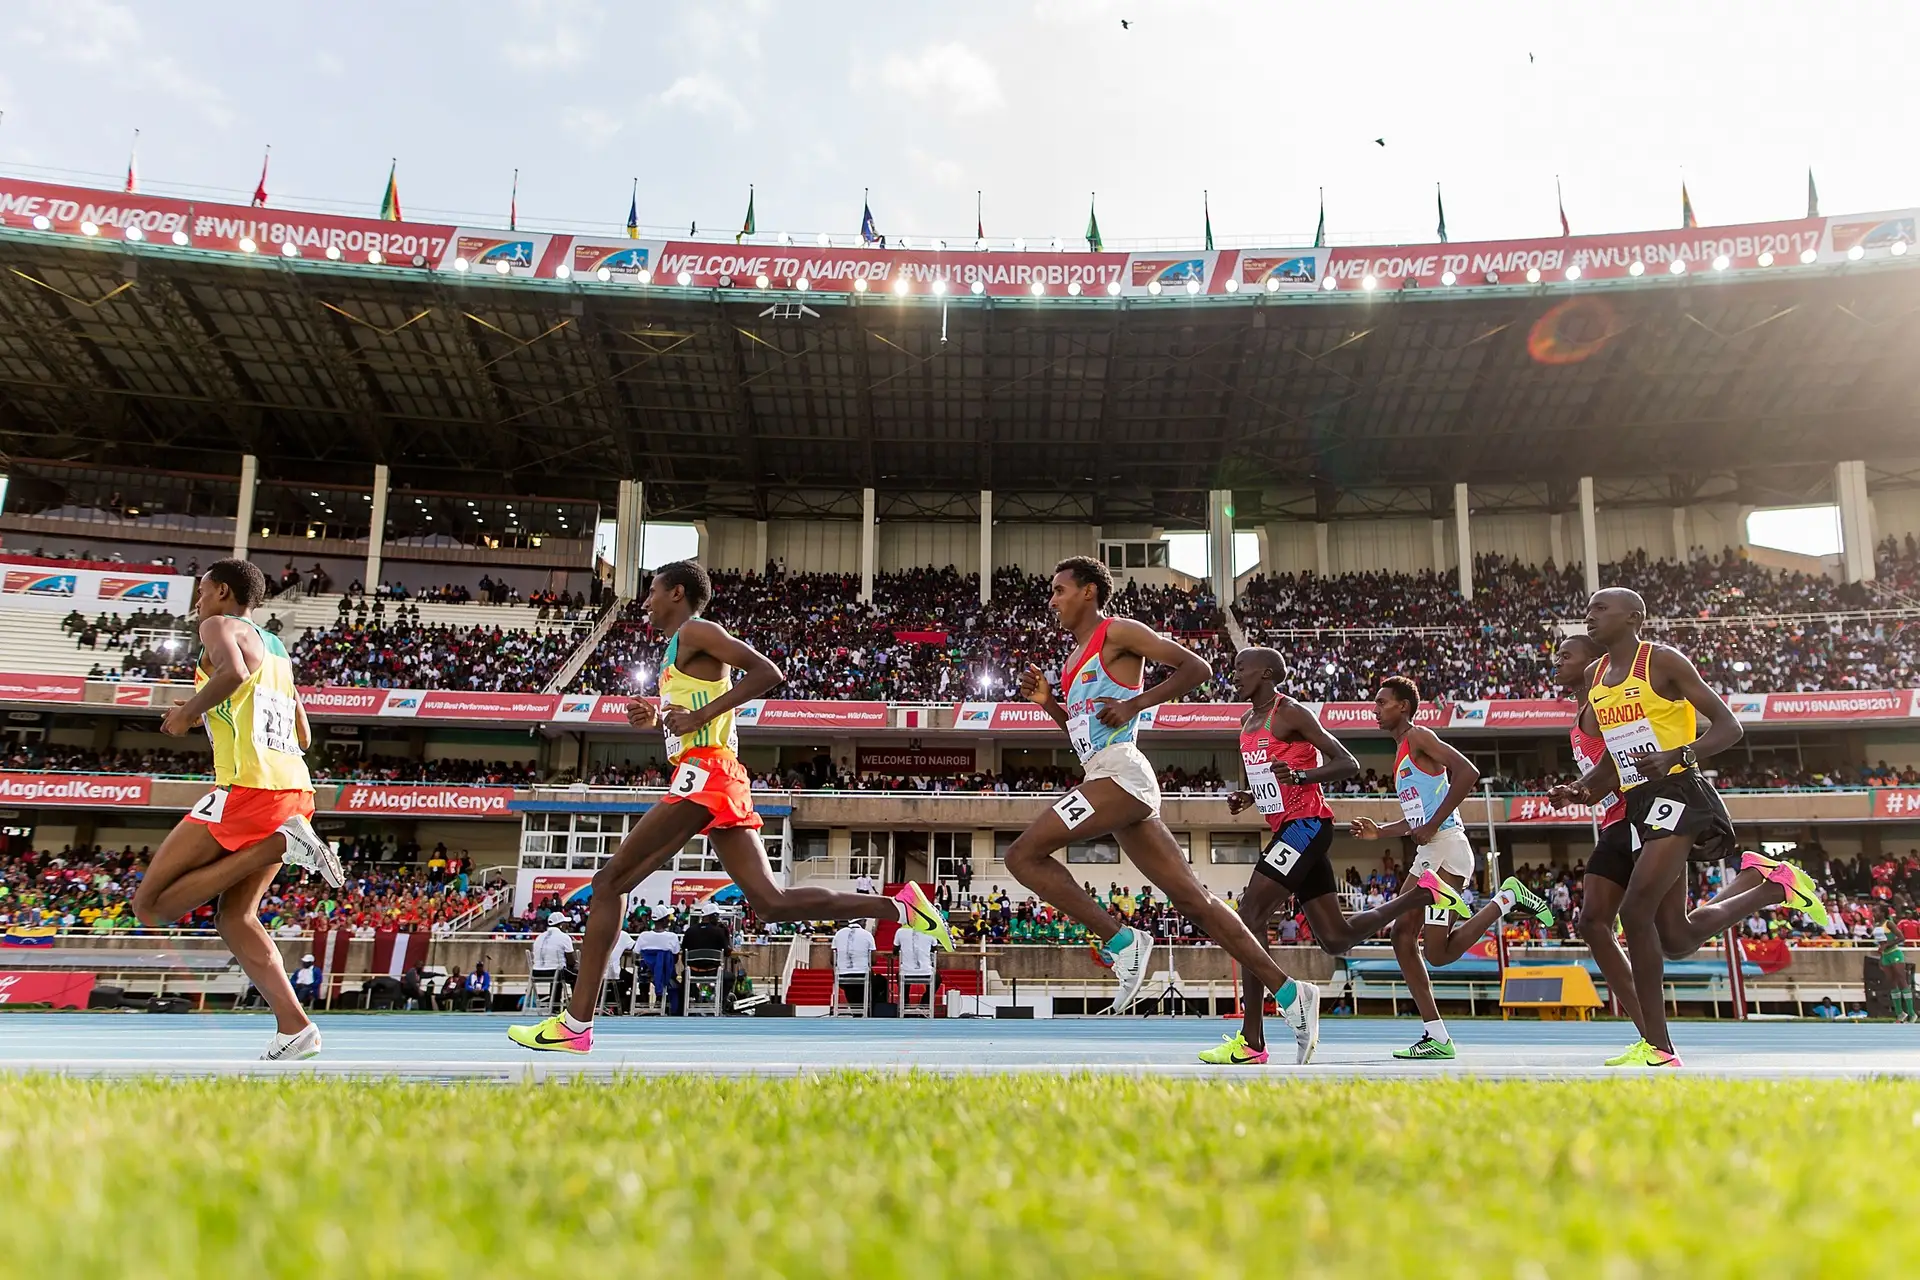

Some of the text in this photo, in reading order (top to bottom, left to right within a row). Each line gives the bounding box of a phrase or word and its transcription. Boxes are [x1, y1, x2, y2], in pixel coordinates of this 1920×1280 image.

[0, 193, 188, 233] ME TO NAIROBI
[194, 215, 446, 258] #WU18NAIROBI2017
[1571, 231, 1819, 270] #WU18NAIROBI2017
[661, 254, 891, 281] WELCOME TO NAIROBI
[898, 262, 1121, 285] #WU18NAIROBI2017
[1328, 249, 1565, 279] WELCOME TO NAIROBI
[424, 701, 443, 709] WU18
[458, 702, 500, 711] Performance
[526, 704, 550, 712] Record
[796, 711, 836, 719] Performance
[860, 712, 884, 720] Record
[1509, 711, 1525, 719] Best
[1525, 710, 1566, 719] Performance
[1772, 697, 1902, 713] #WU18NAIROBI2017
[1177, 714, 1191, 722] Best
[1191, 714, 1230, 722] Performance
[861, 755, 970, 766] WELCOME TO NAIROBI
[679, 770, 697, 793] 3
[198, 792, 216, 817] 2
[350, 788, 505, 812] #MagicalKenya
[1060, 795, 1087, 822] 14
[1267, 803, 1282, 813] 2017
[1655, 803, 1673, 821] 9
[1274, 847, 1292, 866] 5
[1428, 906, 1446, 921] 12
